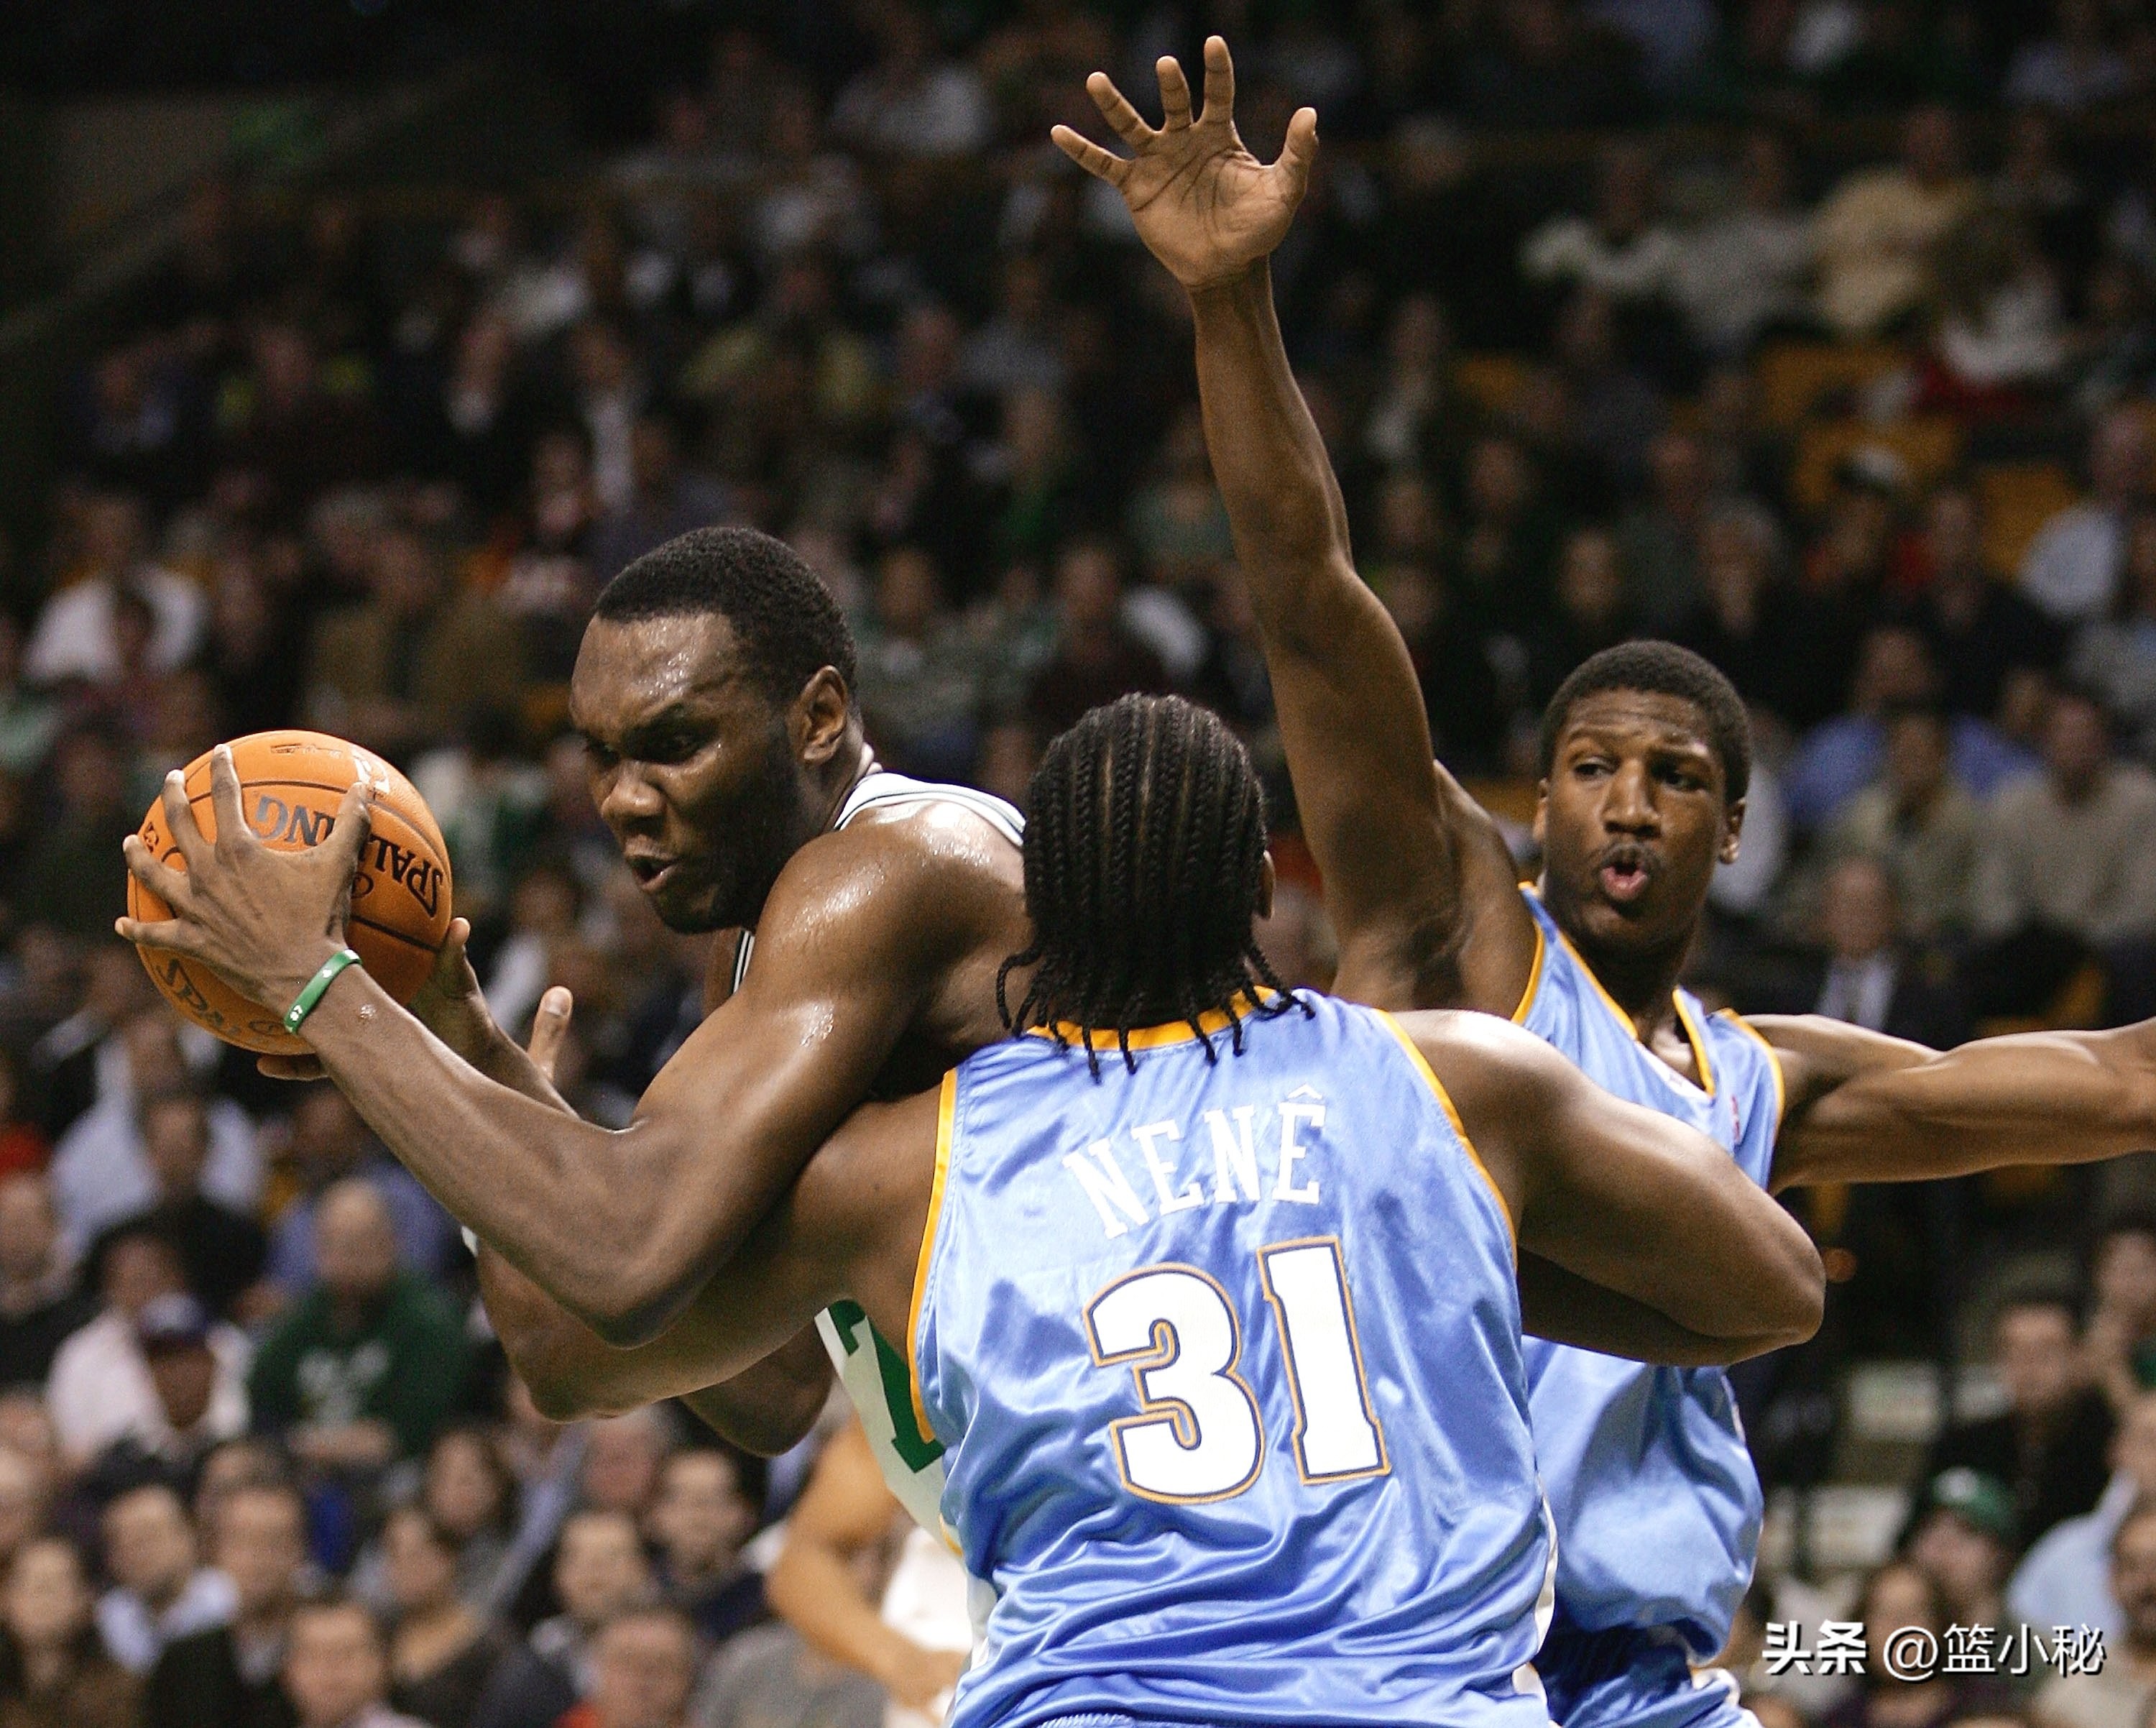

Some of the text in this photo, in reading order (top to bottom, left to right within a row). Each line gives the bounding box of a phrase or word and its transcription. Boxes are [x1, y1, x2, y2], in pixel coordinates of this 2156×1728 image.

[251, 794, 443, 918] SPALNG
[1062, 1085, 1327, 1238] NENÊ
[1083, 1237, 1391, 1504] 31
